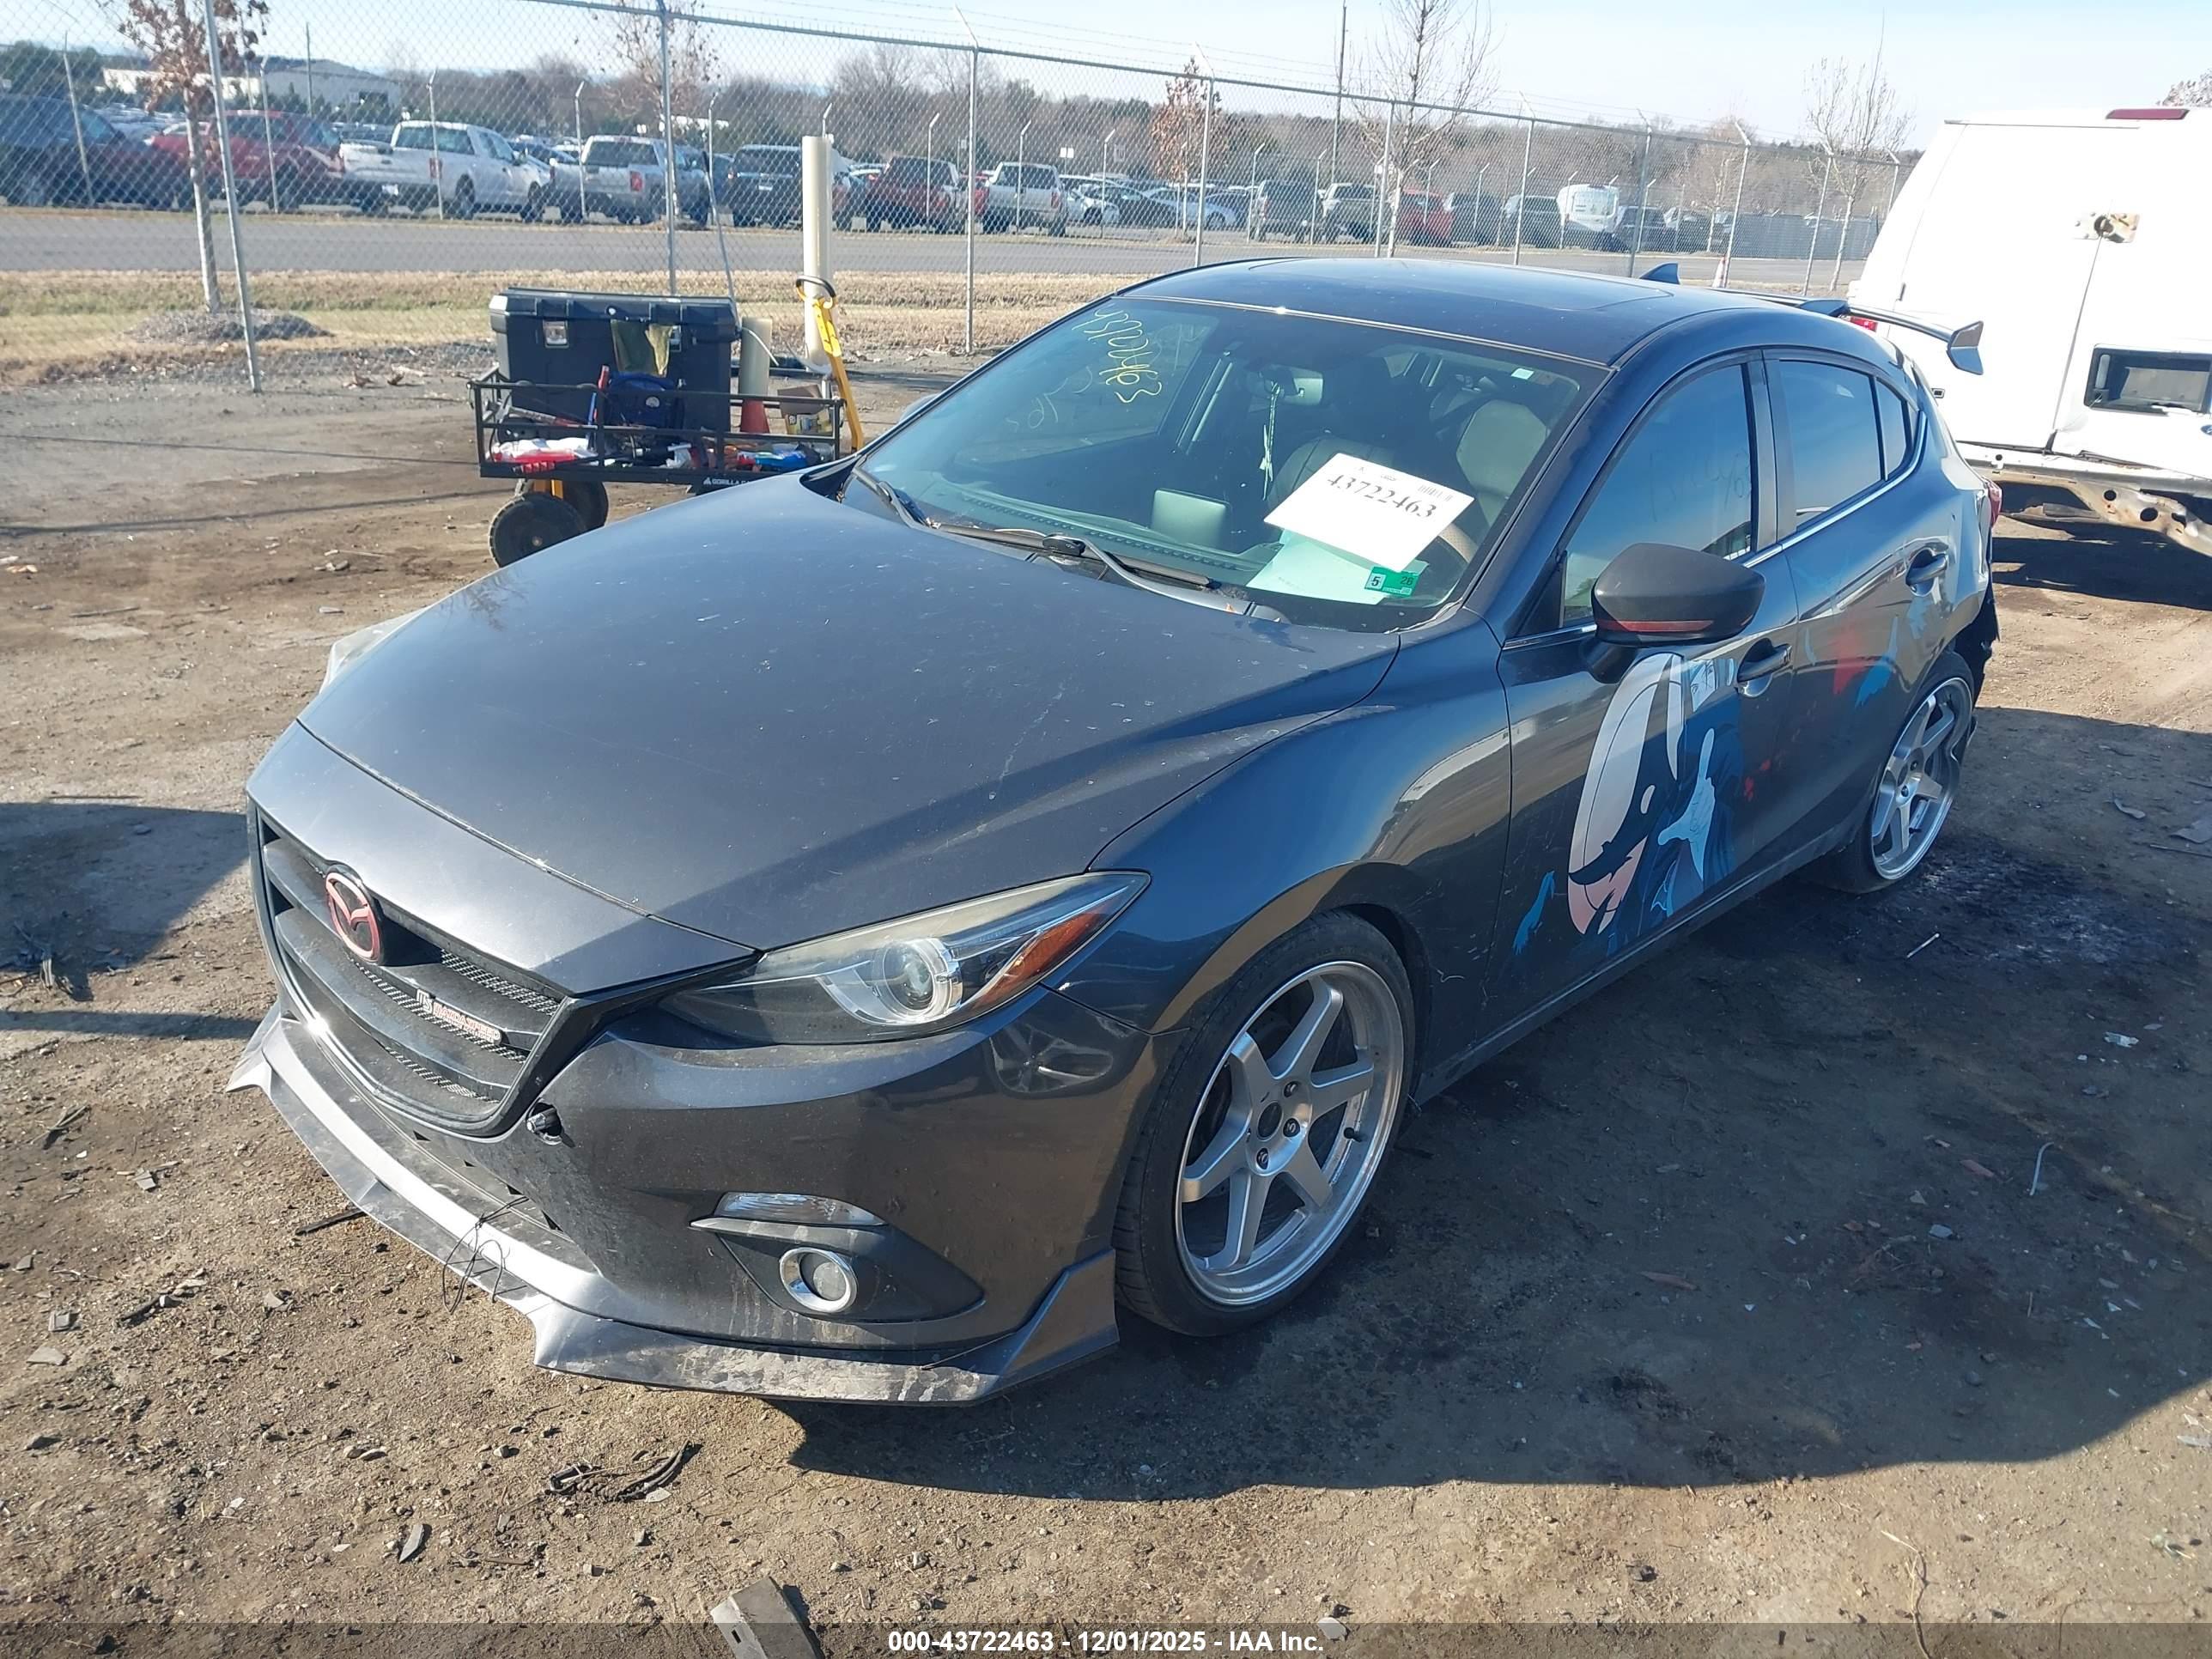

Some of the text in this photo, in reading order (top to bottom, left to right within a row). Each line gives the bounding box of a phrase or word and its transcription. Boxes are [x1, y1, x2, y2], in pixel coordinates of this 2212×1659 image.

[1327, 474, 1437, 518] 43722463
[1370, 575, 1415, 586] 5 26
